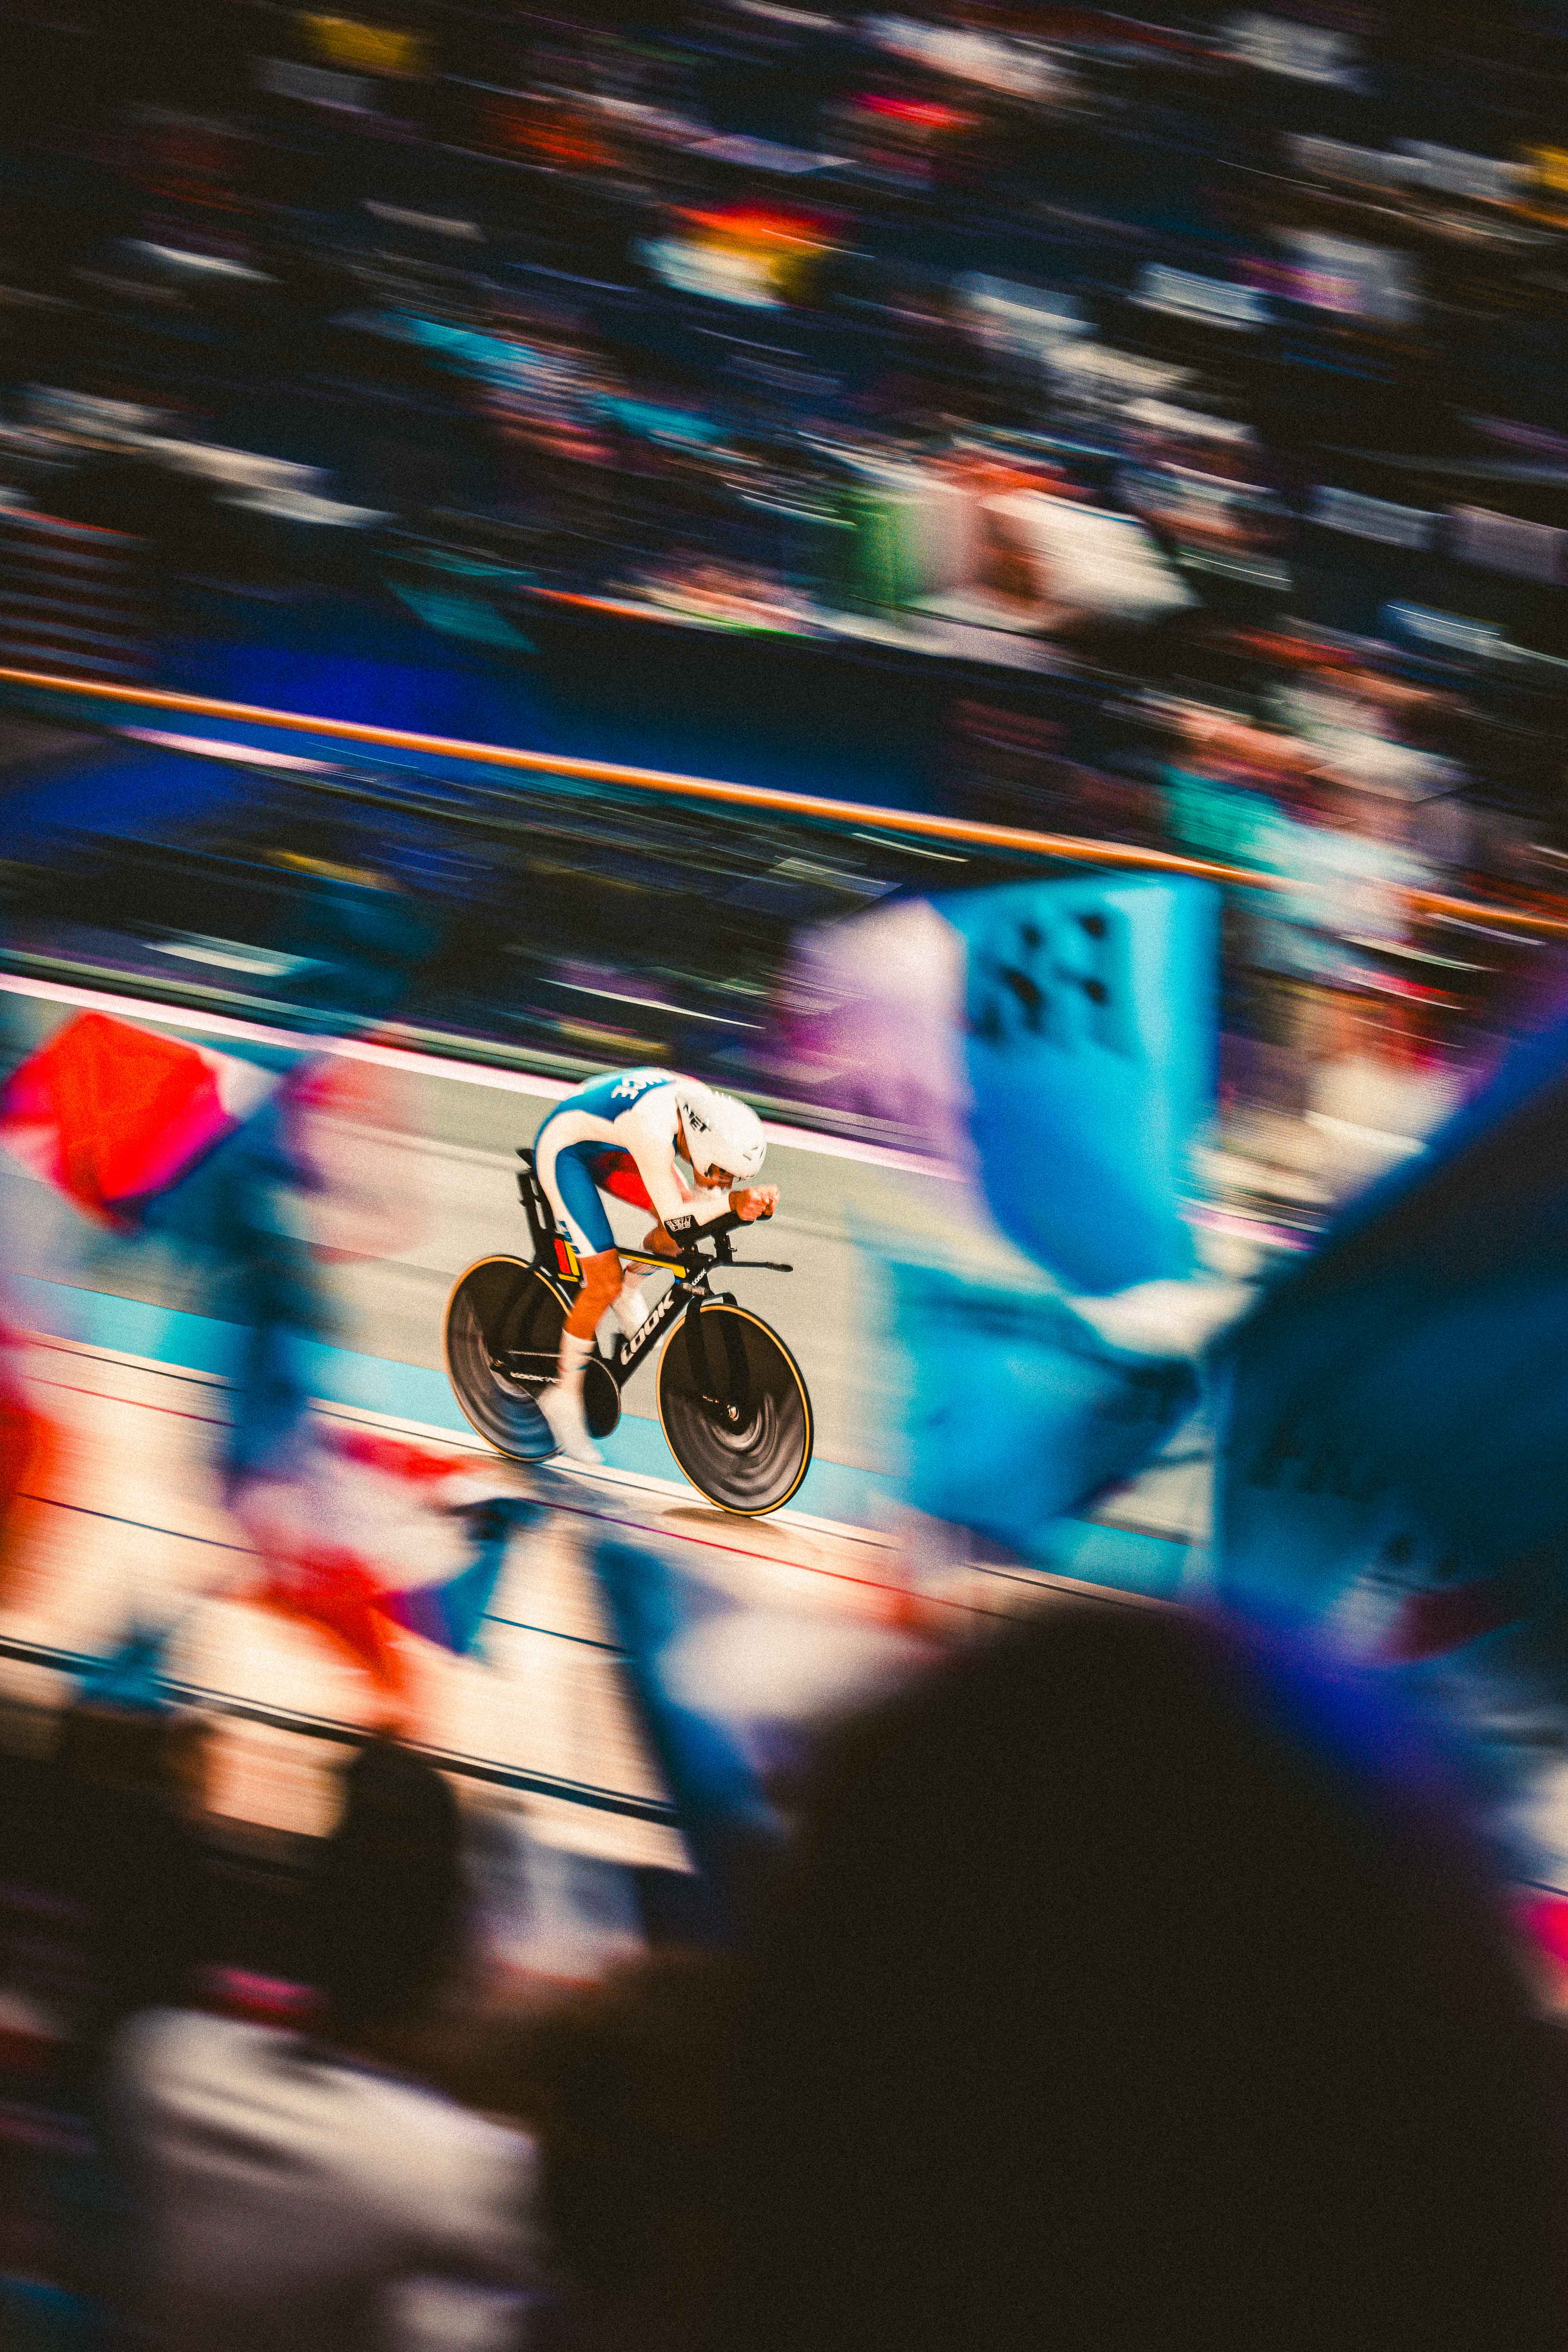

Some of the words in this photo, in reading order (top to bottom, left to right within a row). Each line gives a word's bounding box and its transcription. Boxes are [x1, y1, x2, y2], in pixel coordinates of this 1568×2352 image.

[683, 1103, 711, 1132] MET
[691, 1268, 706, 1286] LOOK
[621, 1289, 674, 1365] LOOK
